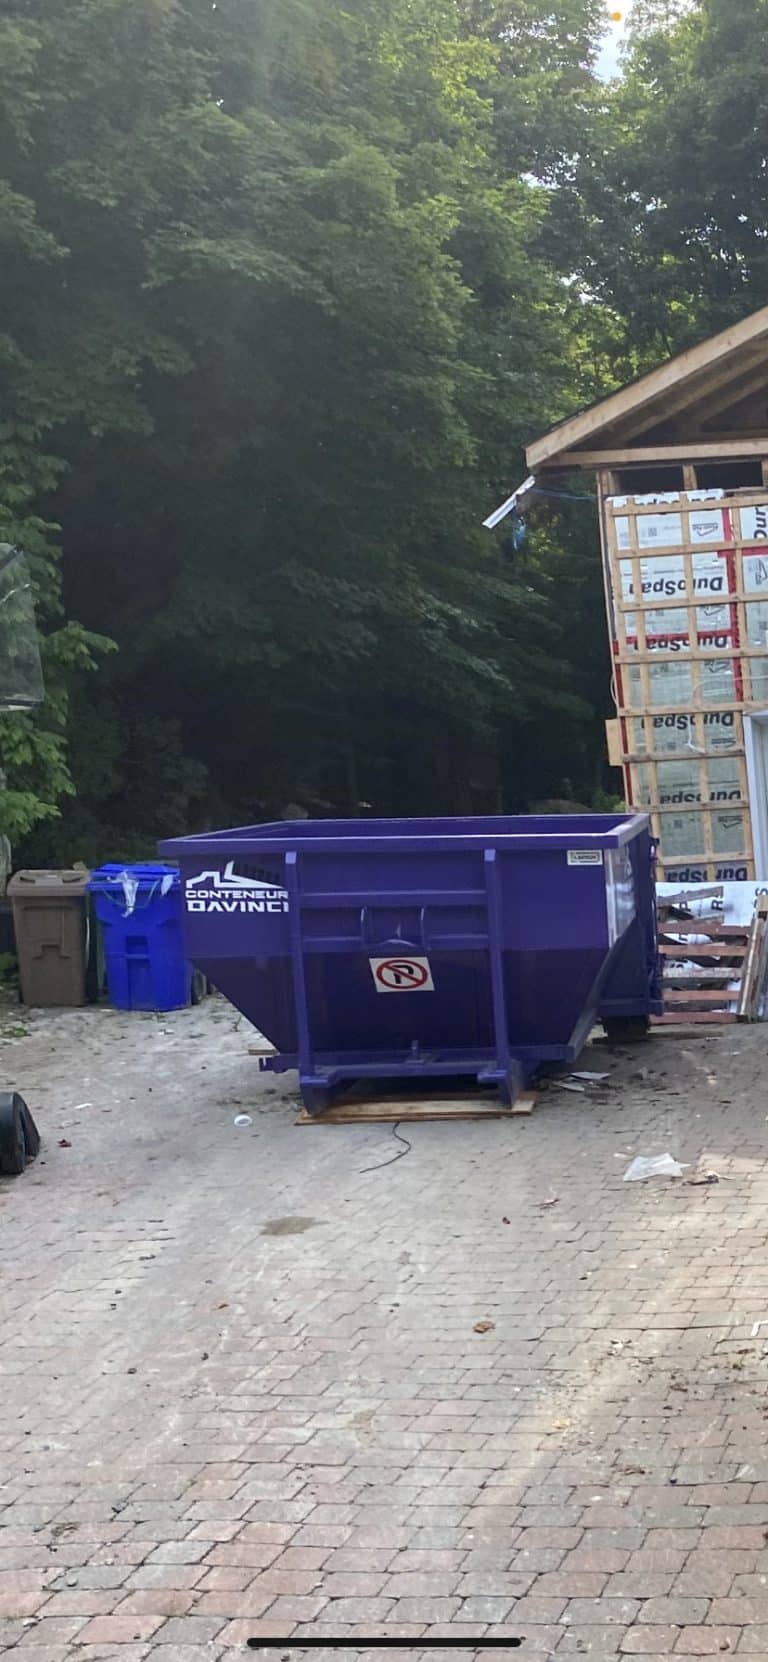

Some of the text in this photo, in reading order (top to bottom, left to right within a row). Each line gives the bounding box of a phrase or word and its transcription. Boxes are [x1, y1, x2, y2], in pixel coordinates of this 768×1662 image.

[641, 712, 733, 730] DurSpa
[185, 890, 289, 899] CONTENEUR
[186, 900, 289, 913] DAVINCI
